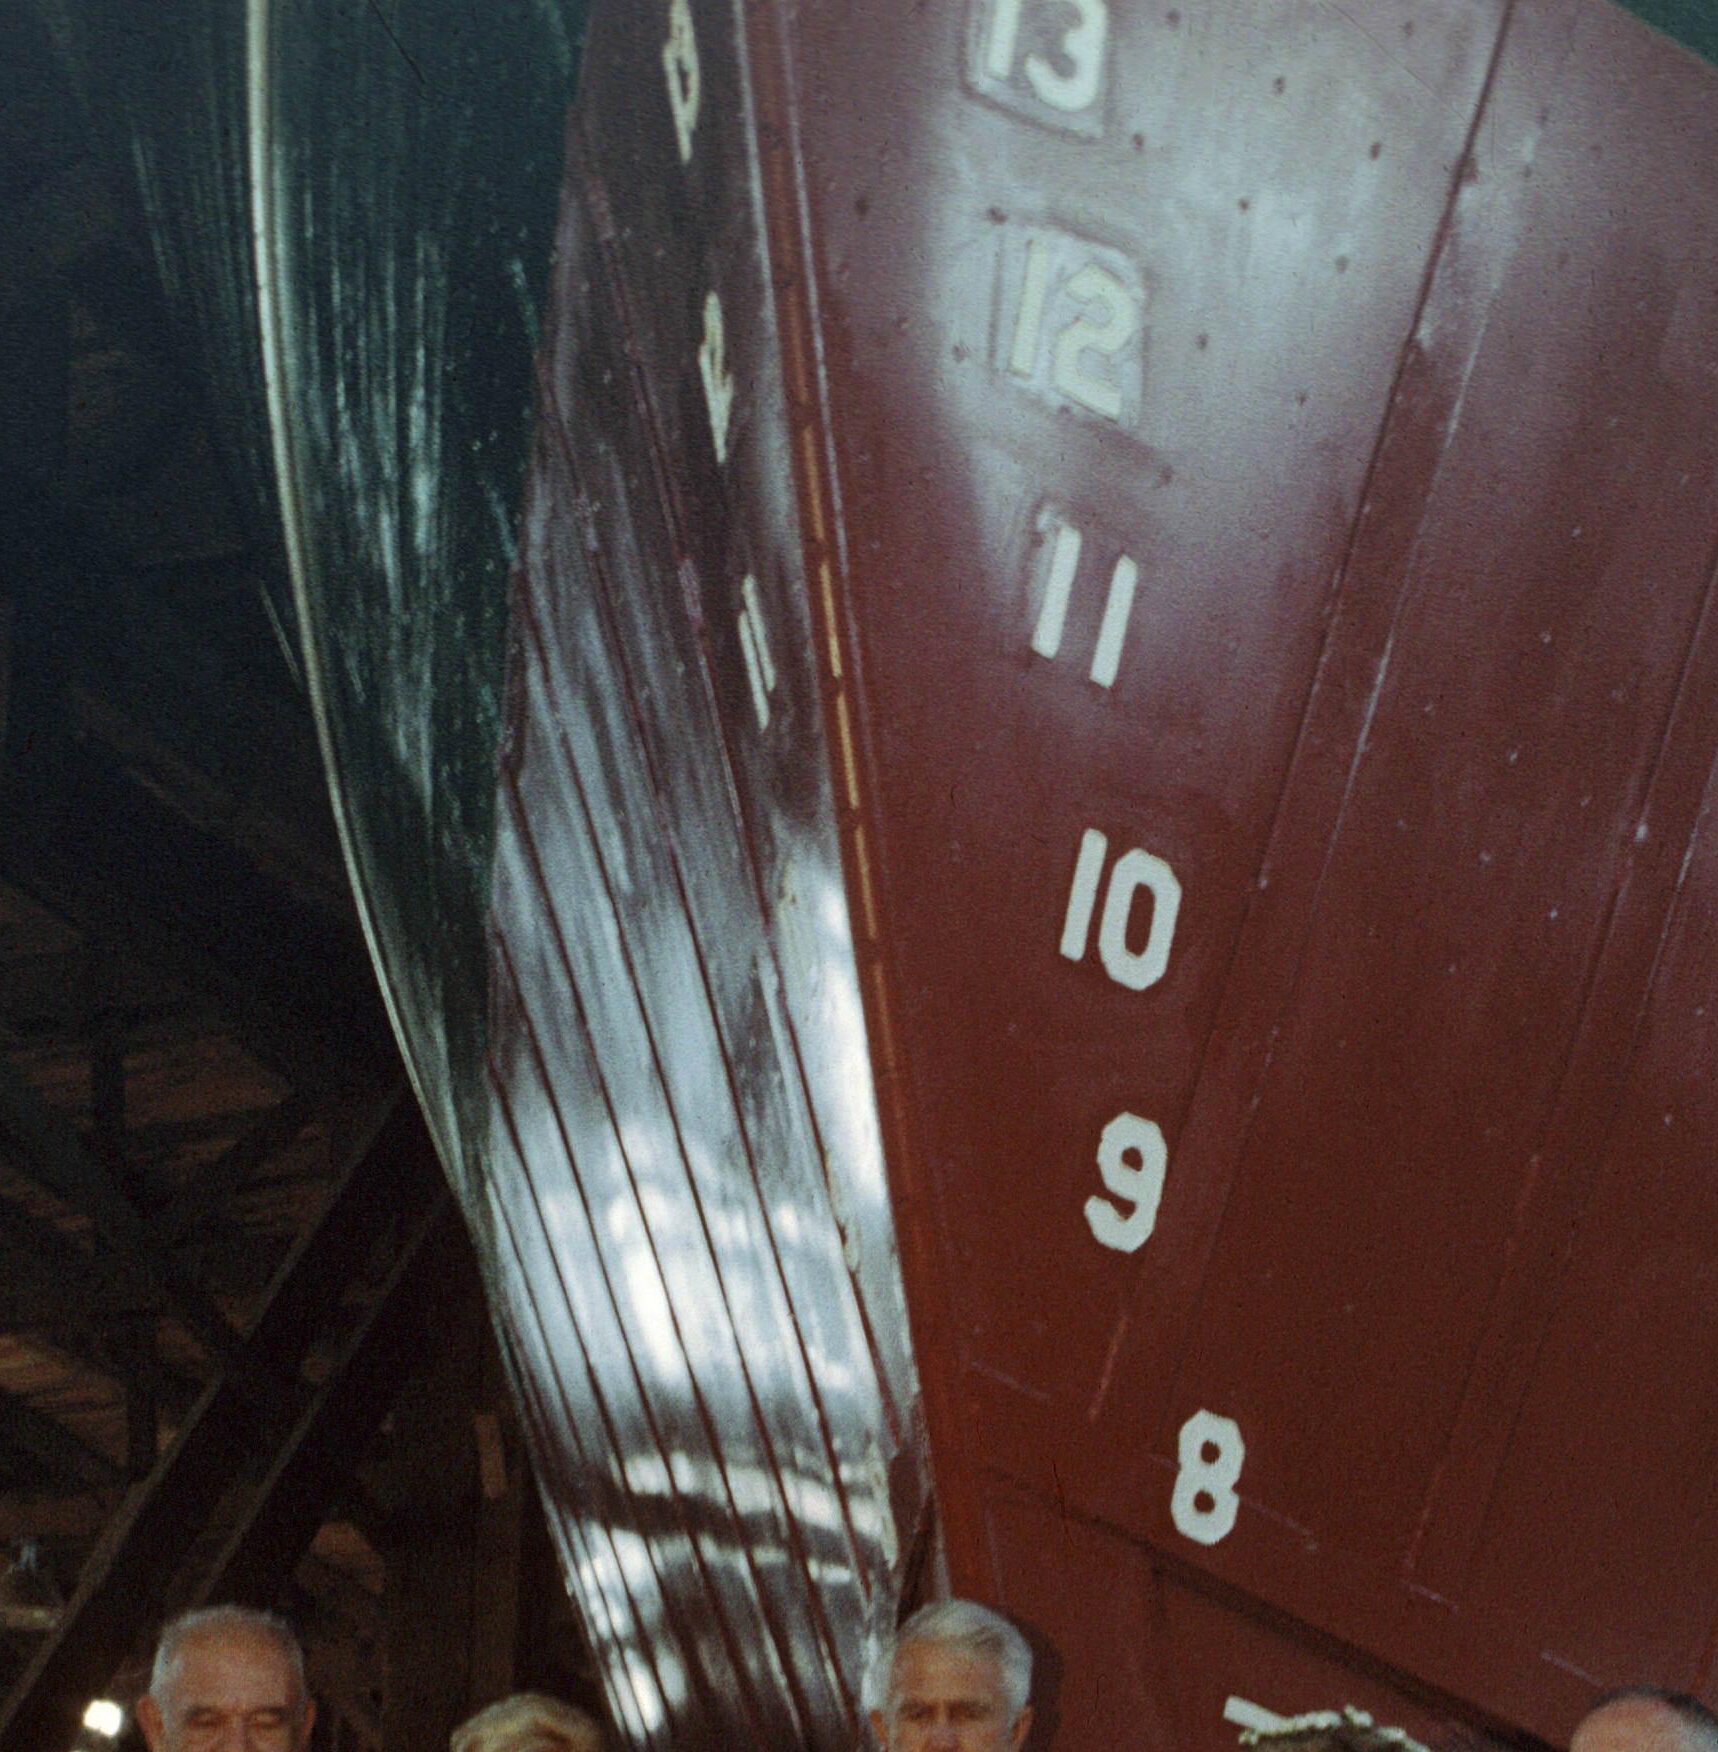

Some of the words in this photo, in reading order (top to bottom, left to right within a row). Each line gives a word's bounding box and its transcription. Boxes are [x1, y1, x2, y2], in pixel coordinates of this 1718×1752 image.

[987, 0, 1108, 112] 13
[1009, 239, 1136, 421] 12
[1031, 525, 1138, 689] 11
[1060, 827, 1182, 991] 10
[1084, 1111, 1168, 1254] 9
[1170, 1408, 1245, 1545] 8
